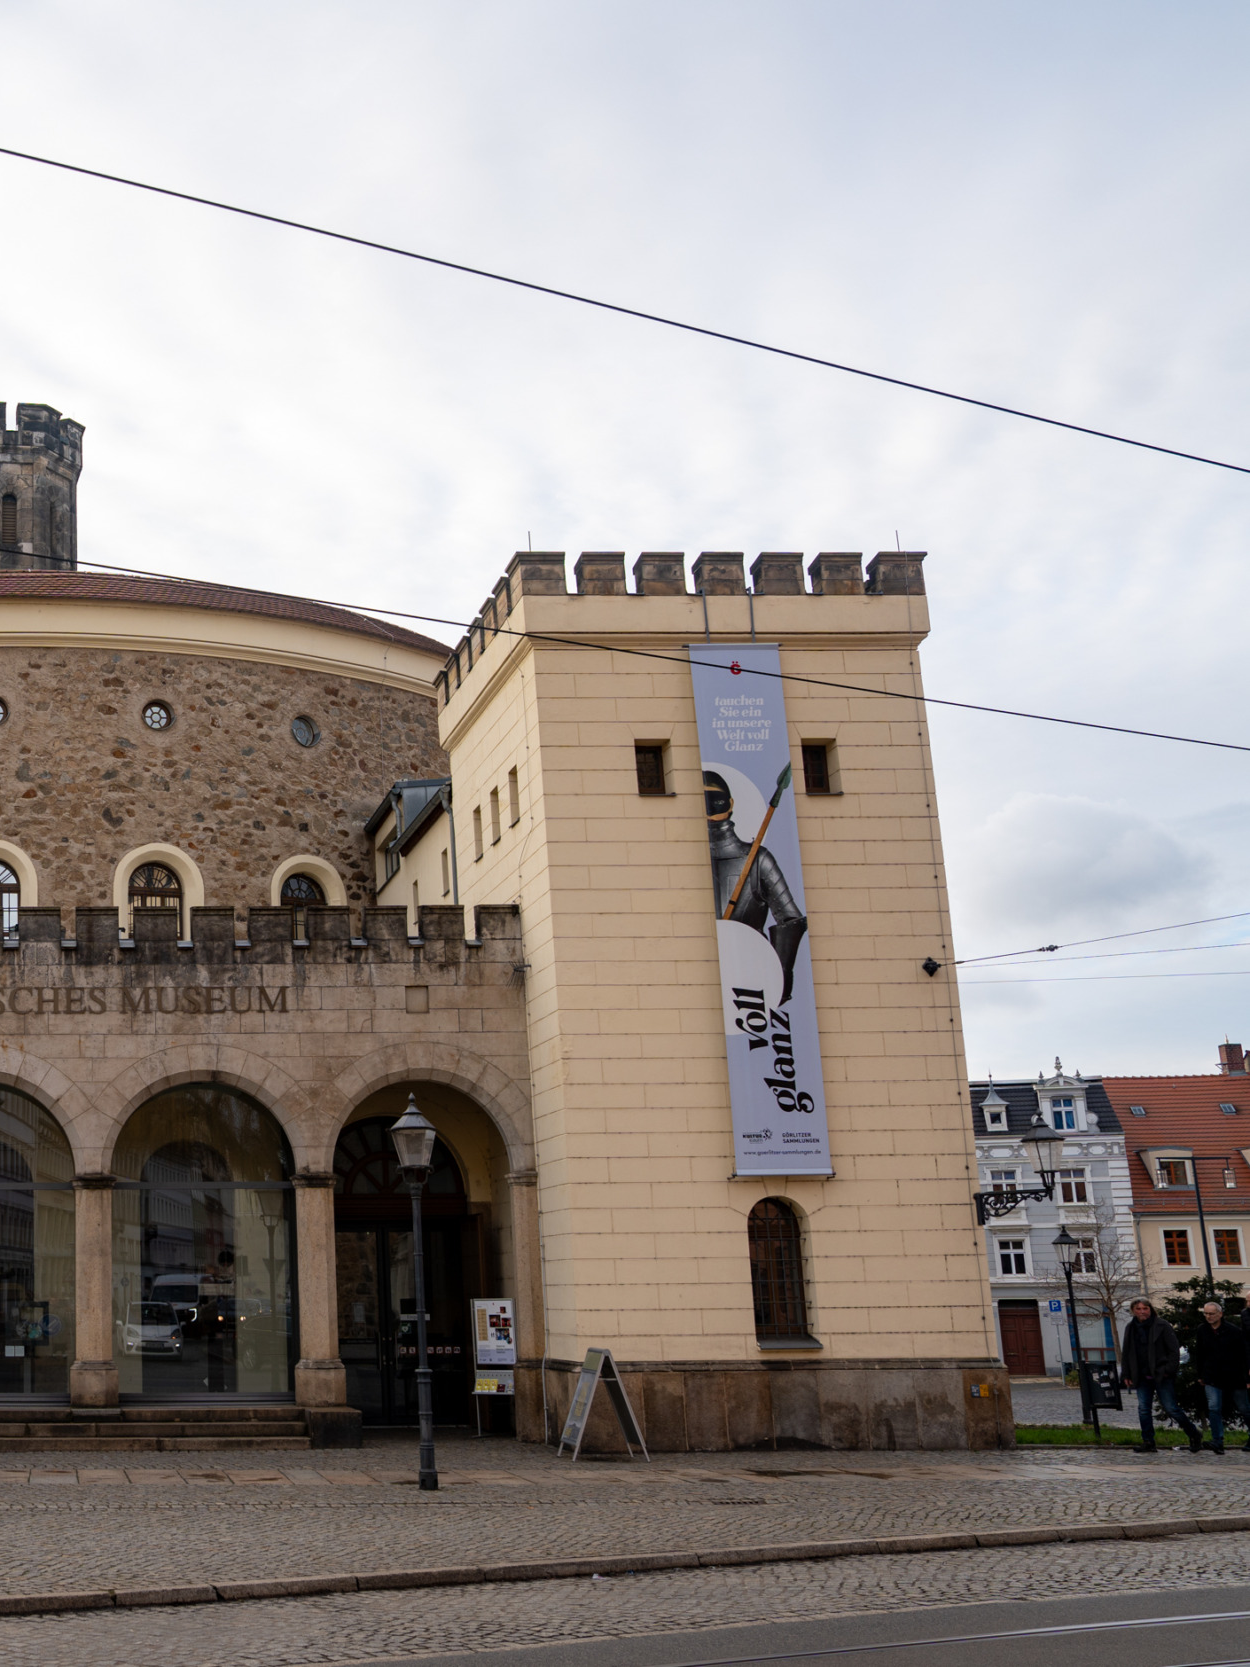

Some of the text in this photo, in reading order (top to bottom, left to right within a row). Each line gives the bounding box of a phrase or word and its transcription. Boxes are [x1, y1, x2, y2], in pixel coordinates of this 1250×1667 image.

[714, 694, 764, 706] tauchen
[719, 706, 762, 717] Sie ein
[712, 718, 772, 728] in unsere
[717, 729, 770, 740] Welt voll
[724, 740, 764, 752] Glanz
[119, 985, 291, 1014] MUSEUM
[731, 987, 769, 1051] voll
[763, 1008, 815, 1114] glanz
[743, 1148, 822, 1156] www.goerlitzer-sammlungen.de
[1051, 1301, 1059, 1311] P
